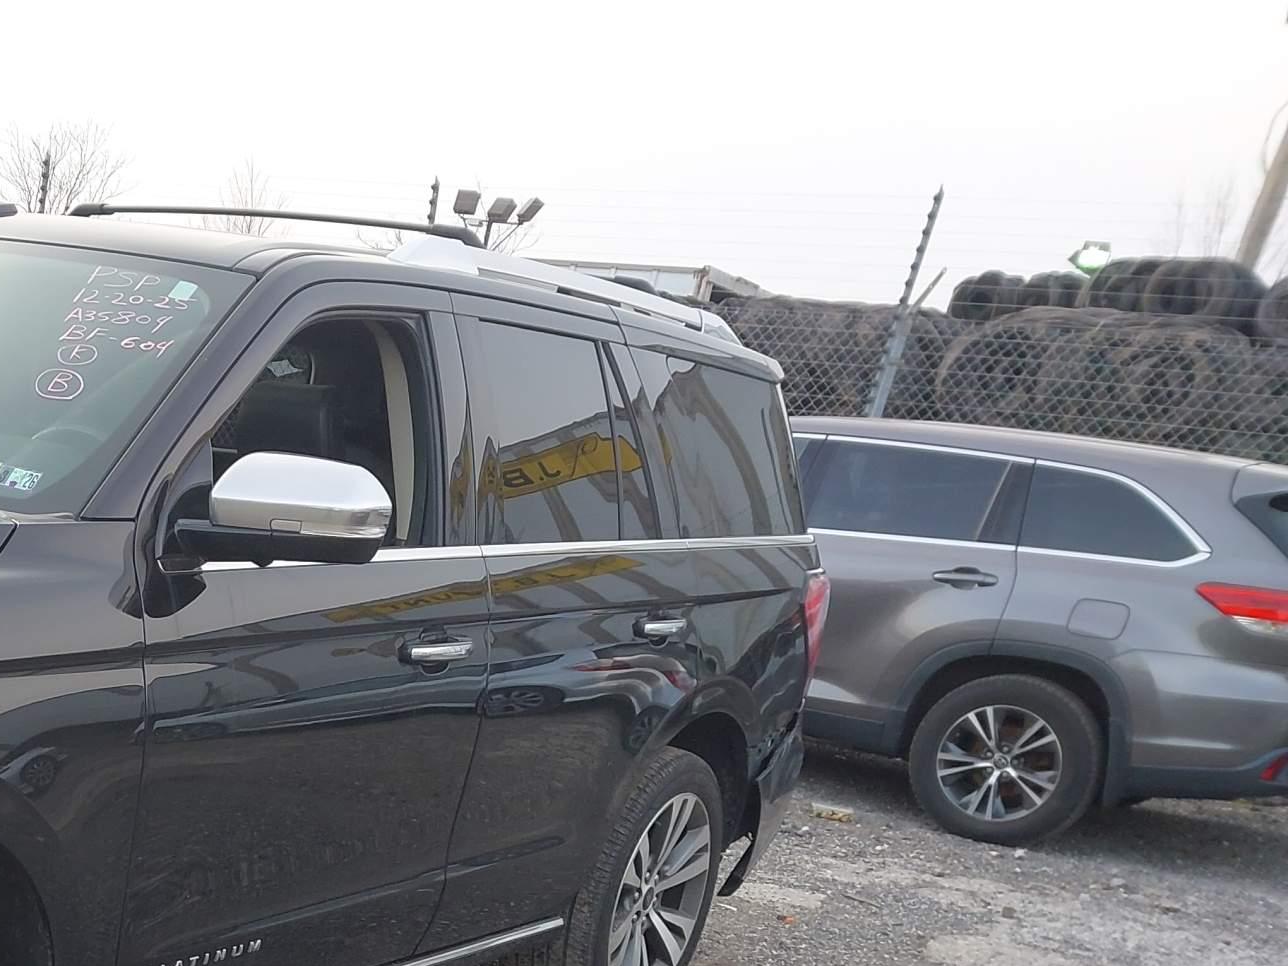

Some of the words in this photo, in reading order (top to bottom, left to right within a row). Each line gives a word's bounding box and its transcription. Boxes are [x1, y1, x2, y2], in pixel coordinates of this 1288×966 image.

[87, 265, 161, 291] PSP
[72, 287, 198, 310] 12-20-25
[58, 324, 175, 358] BF-604
[47, 371, 73, 392] B
